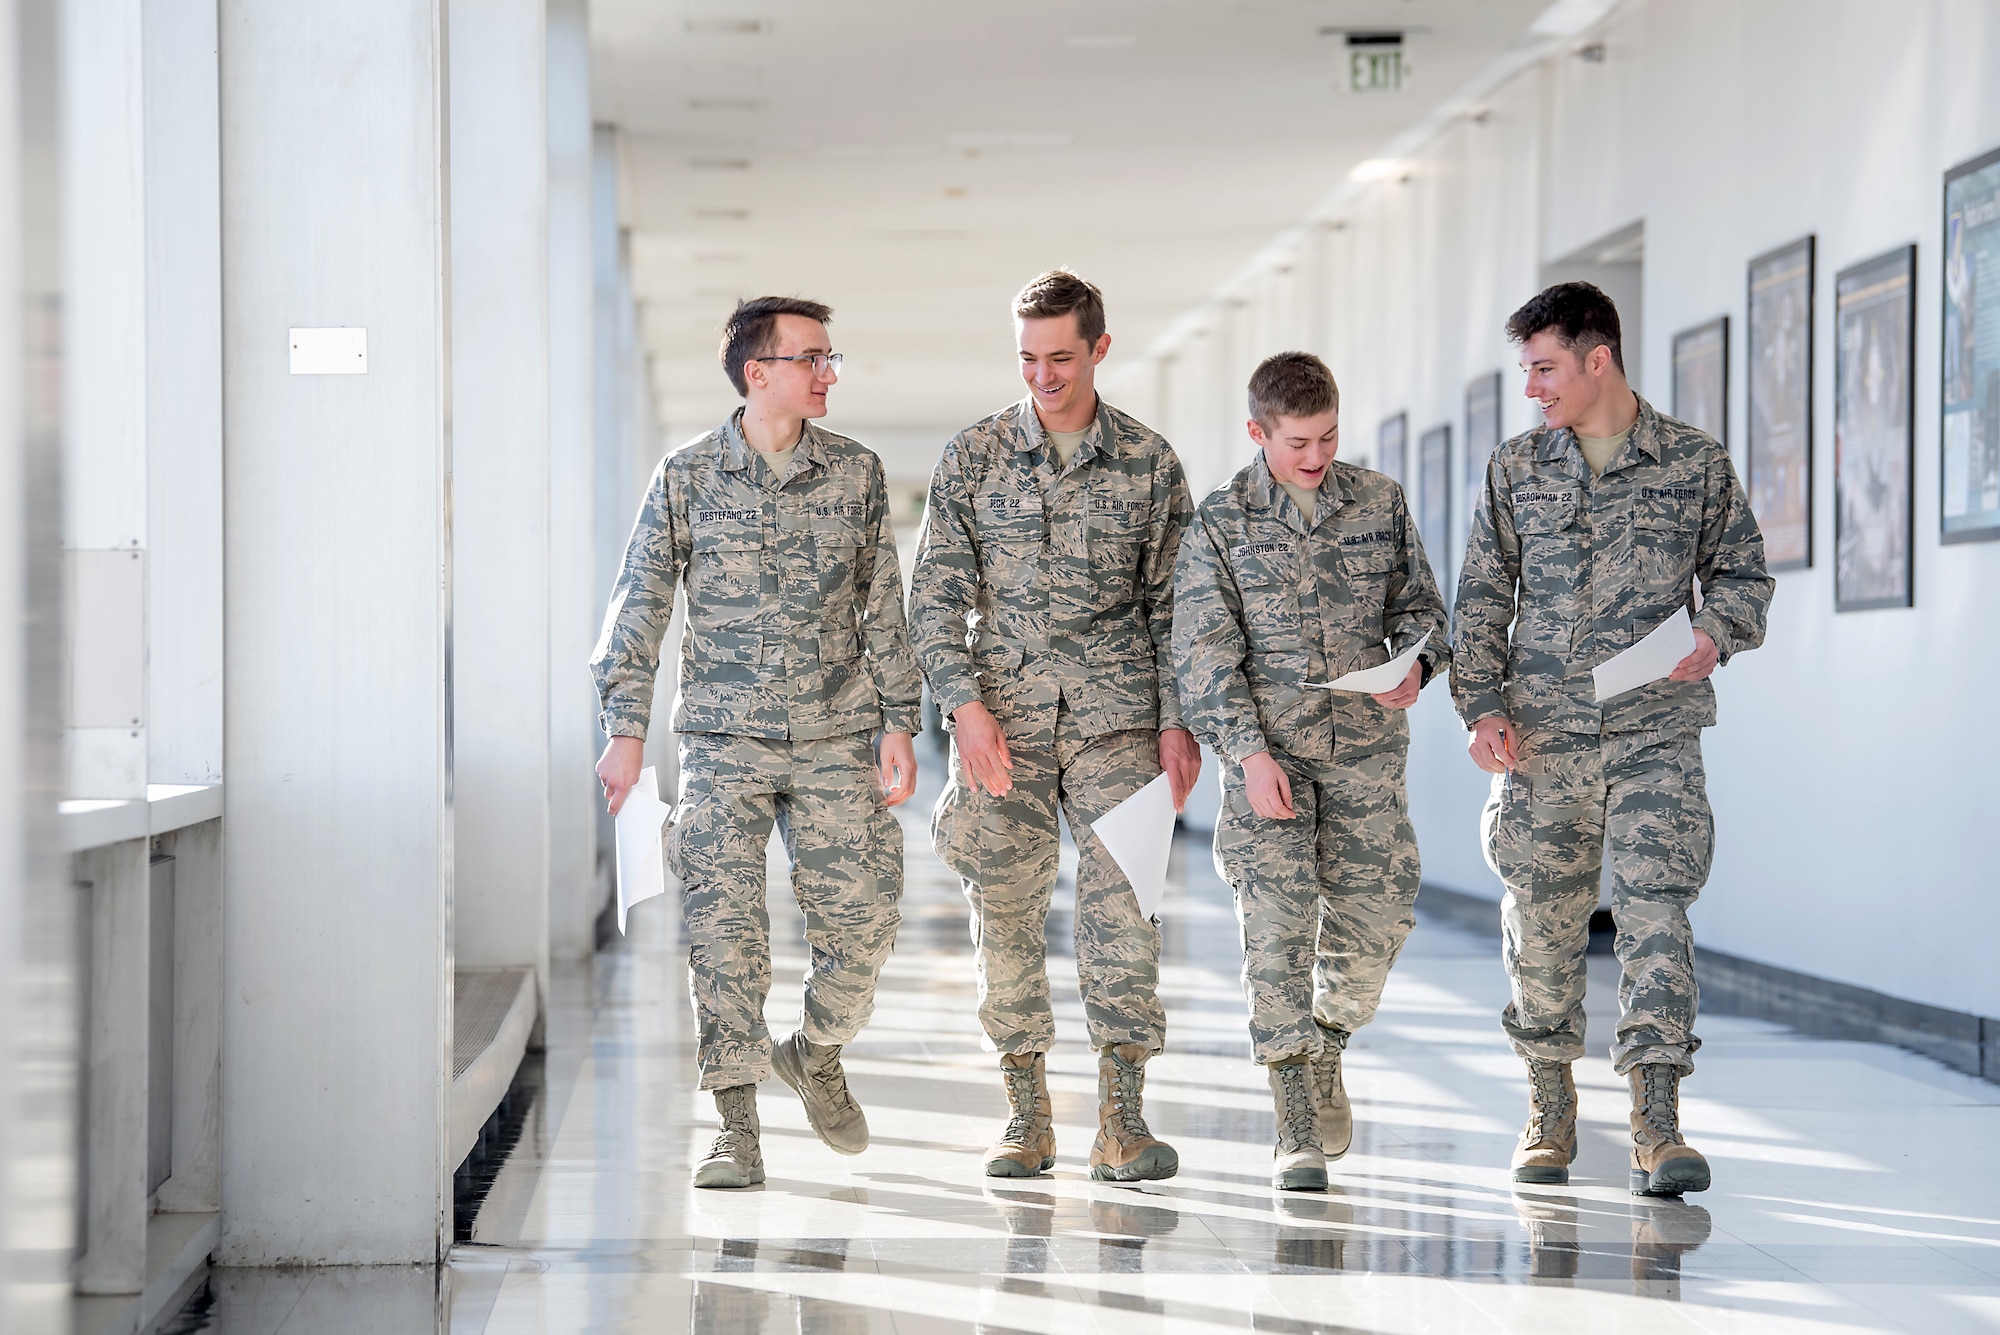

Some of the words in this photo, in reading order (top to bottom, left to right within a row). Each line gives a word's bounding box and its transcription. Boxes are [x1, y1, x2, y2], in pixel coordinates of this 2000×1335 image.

[1350, 50, 1402, 93] EXIT
[1561, 492, 1572, 502] 22
[1641, 487, 1656, 499] U.S.
[1659, 489, 1673, 499] AIR
[1674, 488, 1697, 500] FORCE
[1009, 498, 1020, 508] 22
[1095, 499, 1109, 510] U.S.
[1112, 500, 1124, 511] AIR
[1127, 501, 1146, 512] FORCE
[700, 510, 742, 522] DESTEFANO
[745, 510, 757, 520] 22
[815, 506, 831, 517] U.S.
[834, 505, 845, 516] AIR
[1237, 543, 1275, 558] JOHNSTON
[1277, 543, 1289, 552] 22
